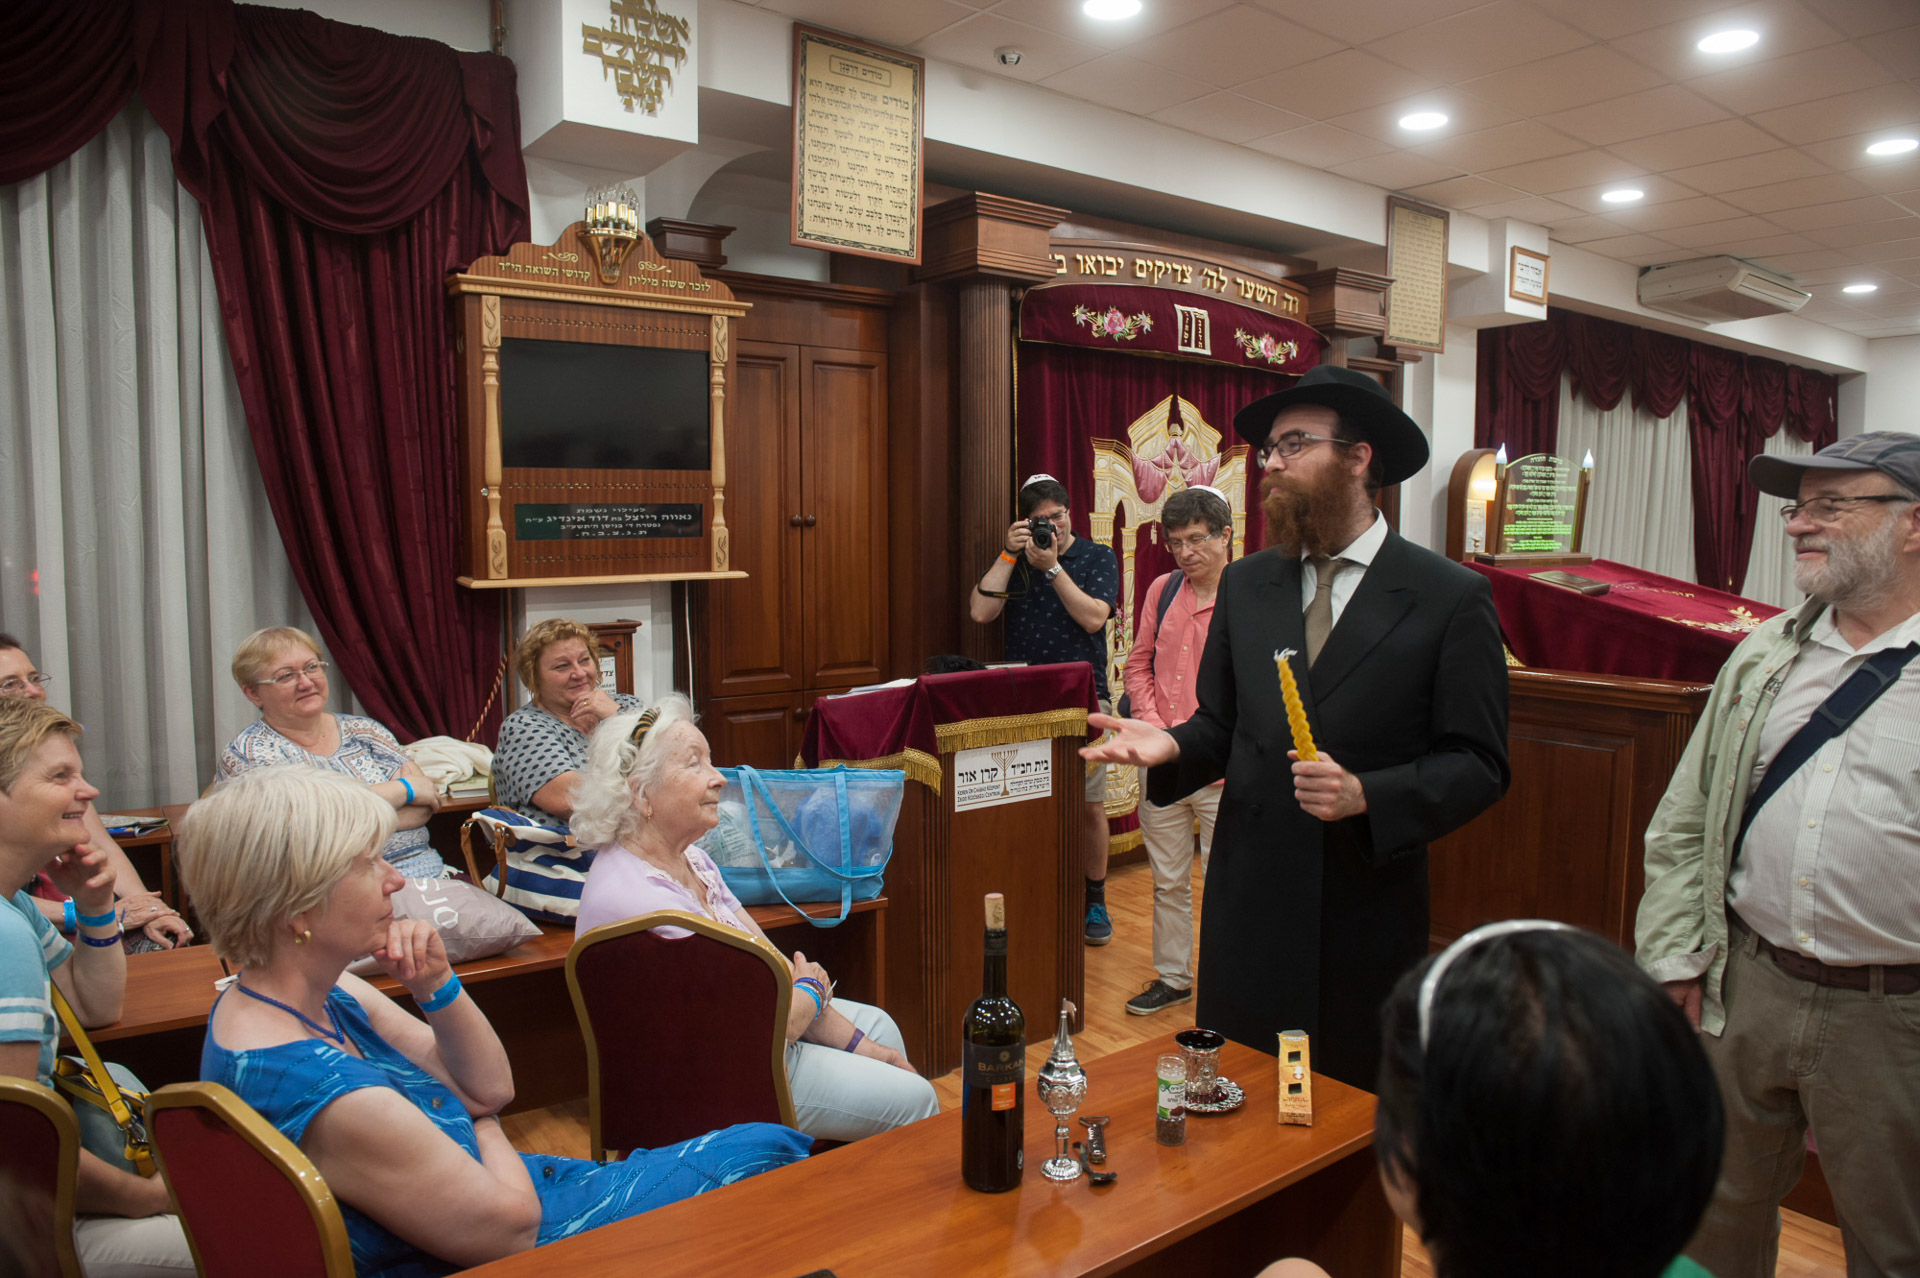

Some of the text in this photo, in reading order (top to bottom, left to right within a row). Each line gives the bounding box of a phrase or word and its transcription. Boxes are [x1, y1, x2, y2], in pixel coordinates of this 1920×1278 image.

[525, 264, 559, 277] השואה
[1075, 254, 1124, 276] יבואו
[1135, 258, 1193, 285] צדיקים
[562, 269, 591, 282] קדושי
[628, 274, 659, 287] מיליון
[661, 278, 686, 290] ששה
[689, 281, 711, 292] לזכר
[1236, 277, 1278, 306] השער
[589, 514, 609, 522] דוד
[1034, 760, 1049, 772] בית
[958, 770, 976, 783] אור
[981, 767, 998, 784] קרן
[978, 1058, 1024, 1072] BARKAN
